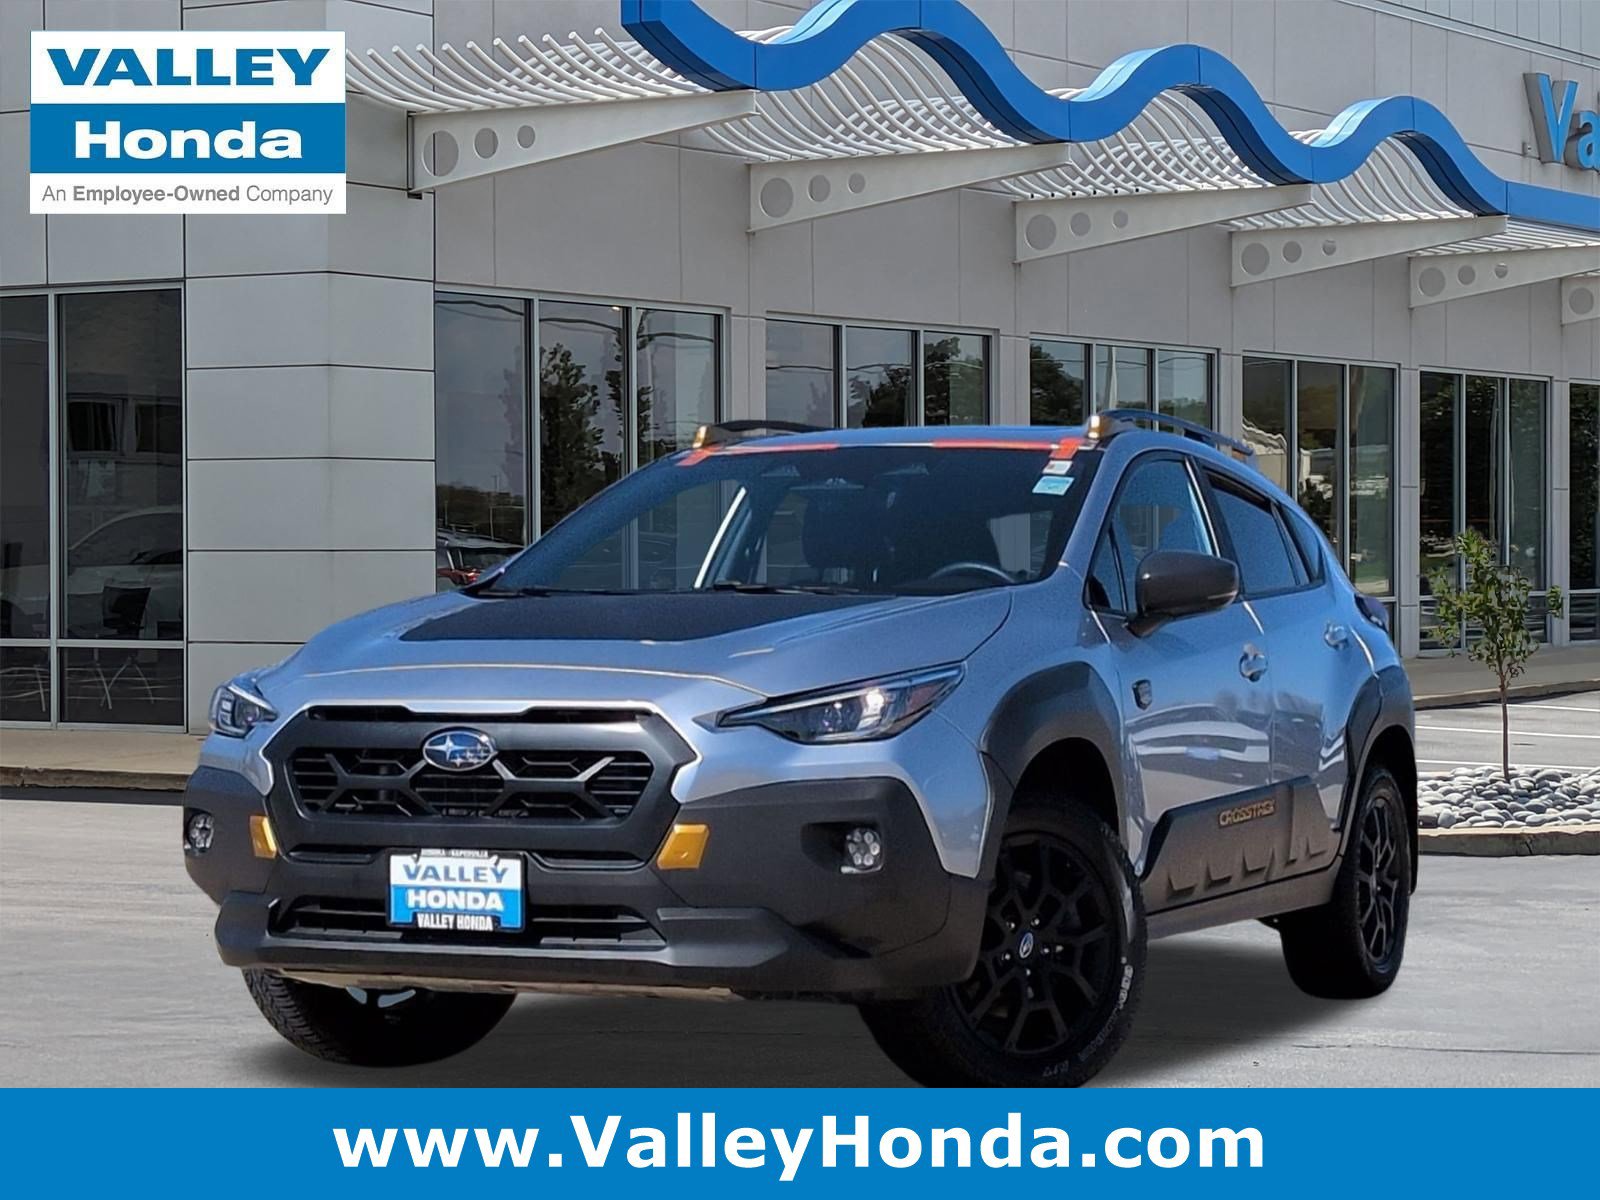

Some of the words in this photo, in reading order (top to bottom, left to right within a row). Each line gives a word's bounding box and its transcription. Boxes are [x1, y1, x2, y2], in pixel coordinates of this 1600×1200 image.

[403, 864, 508, 883] VALLEY
[407, 888, 504, 912] HONDA
[416, 912, 455, 929] VALLEY
[456, 914, 494, 931] HONDA
